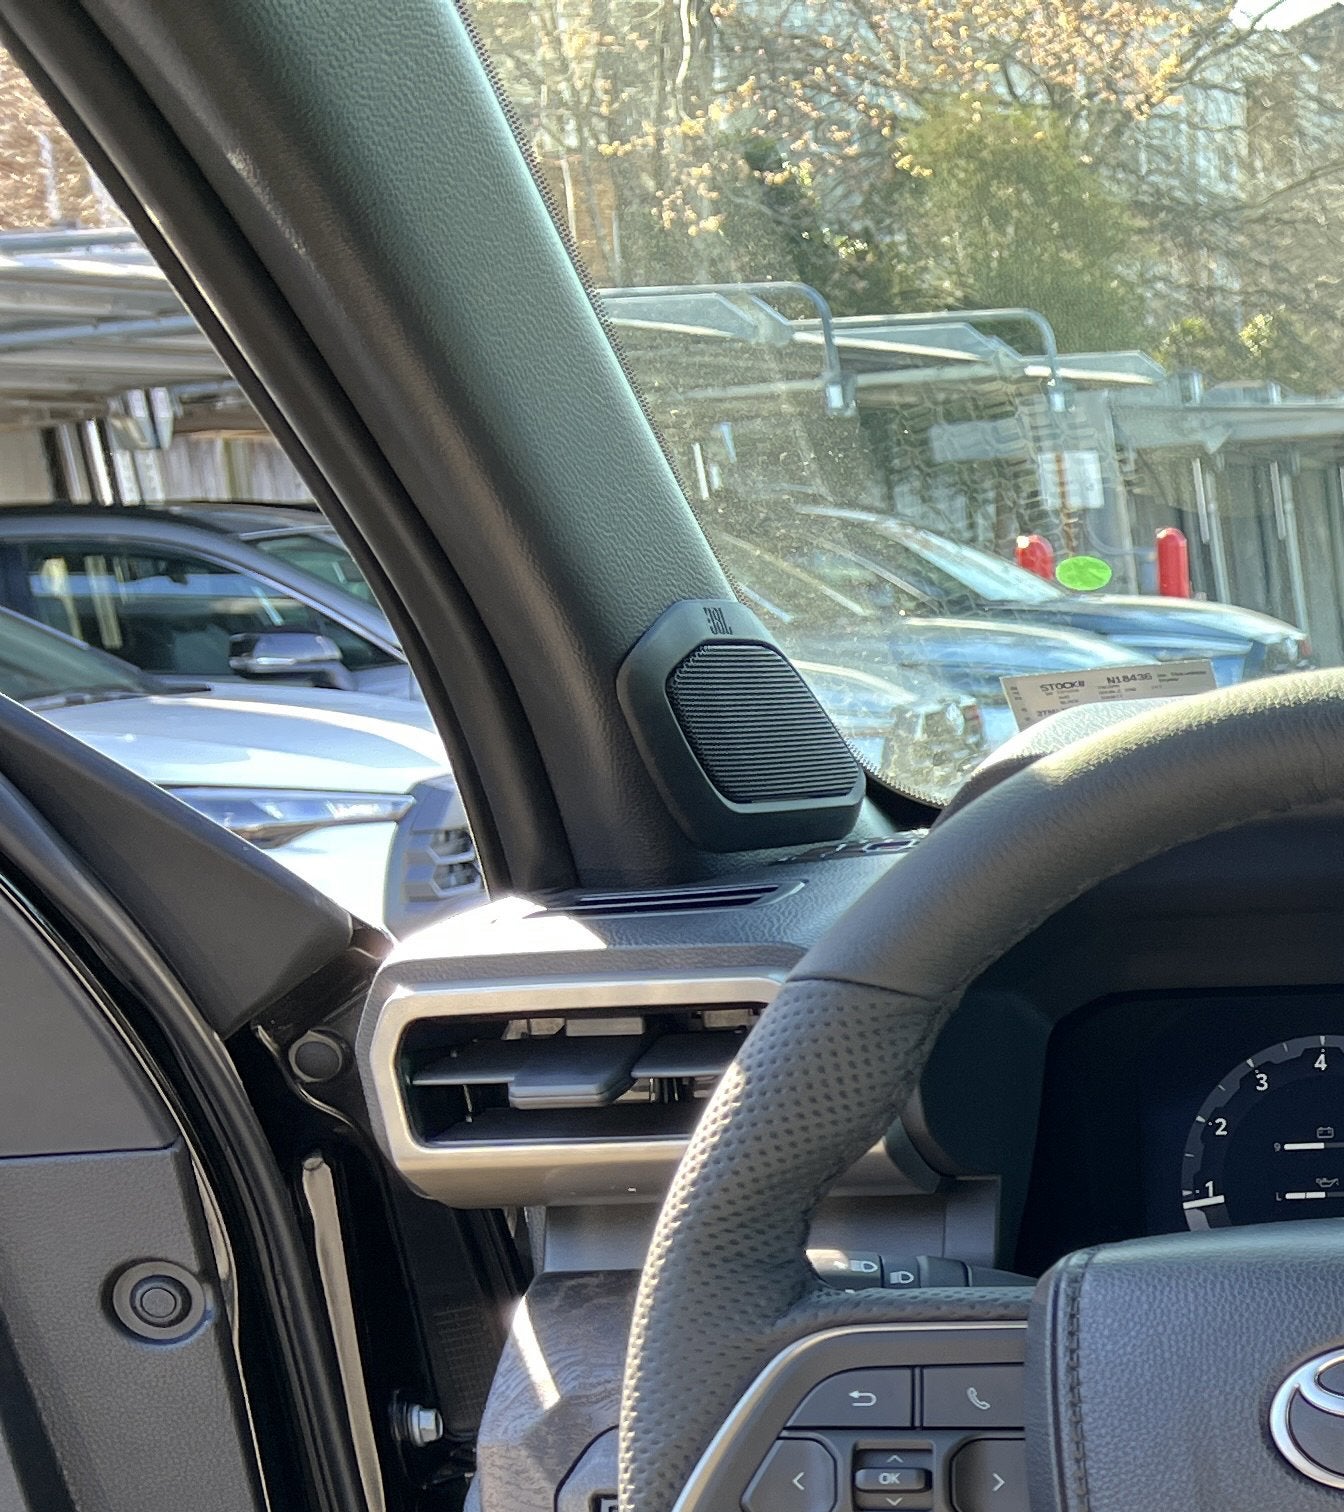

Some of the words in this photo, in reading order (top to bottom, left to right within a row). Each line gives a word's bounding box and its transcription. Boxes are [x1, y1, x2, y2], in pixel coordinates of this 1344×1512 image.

[1314, 1054, 1328, 1071] 4
[1255, 1073, 1269, 1091] 3
[1214, 1118, 1228, 1136] 2
[1204, 1180, 1214, 1197] 1
[1275, 1192, 1282, 1201] L
[878, 1472, 901, 1485] OK
